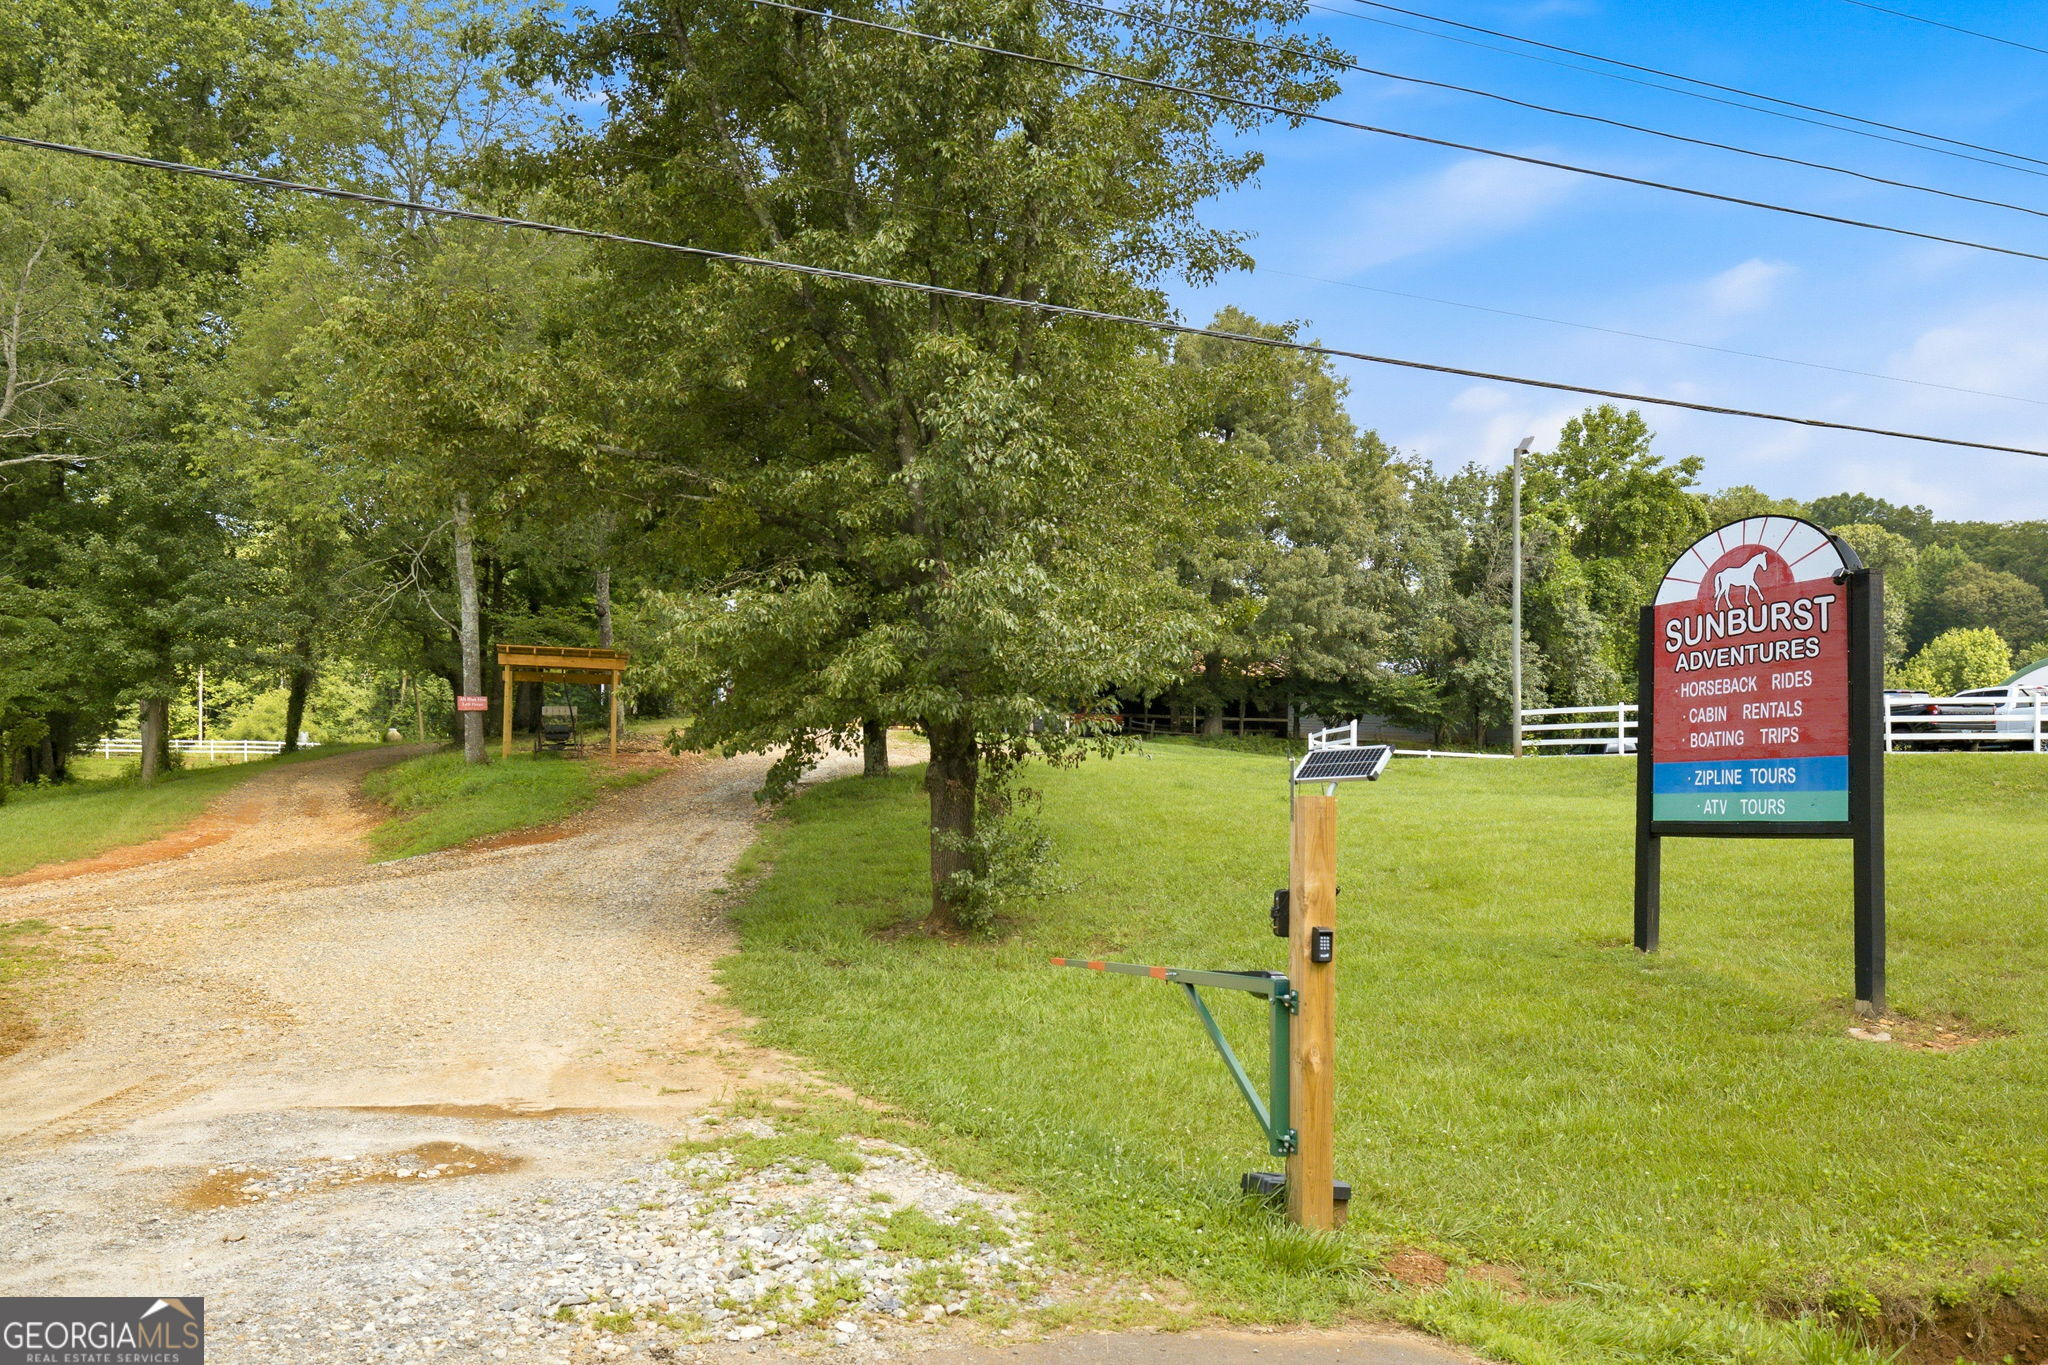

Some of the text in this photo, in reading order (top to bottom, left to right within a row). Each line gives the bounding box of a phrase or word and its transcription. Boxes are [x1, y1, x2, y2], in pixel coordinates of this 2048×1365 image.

[1665, 594, 1836, 653] SUNBURST
[1674, 636, 1820, 673] ADVENTURES
[1681, 670, 1813, 698] HORSEBACK RIDES
[1689, 700, 1803, 724] CABIN RENTALS
[1690, 727, 1799, 748] BOATING TRIPS
[1694, 767, 1796, 786] ZIPLINE TOURS
[1703, 799, 1785, 815] ATV TOURS
